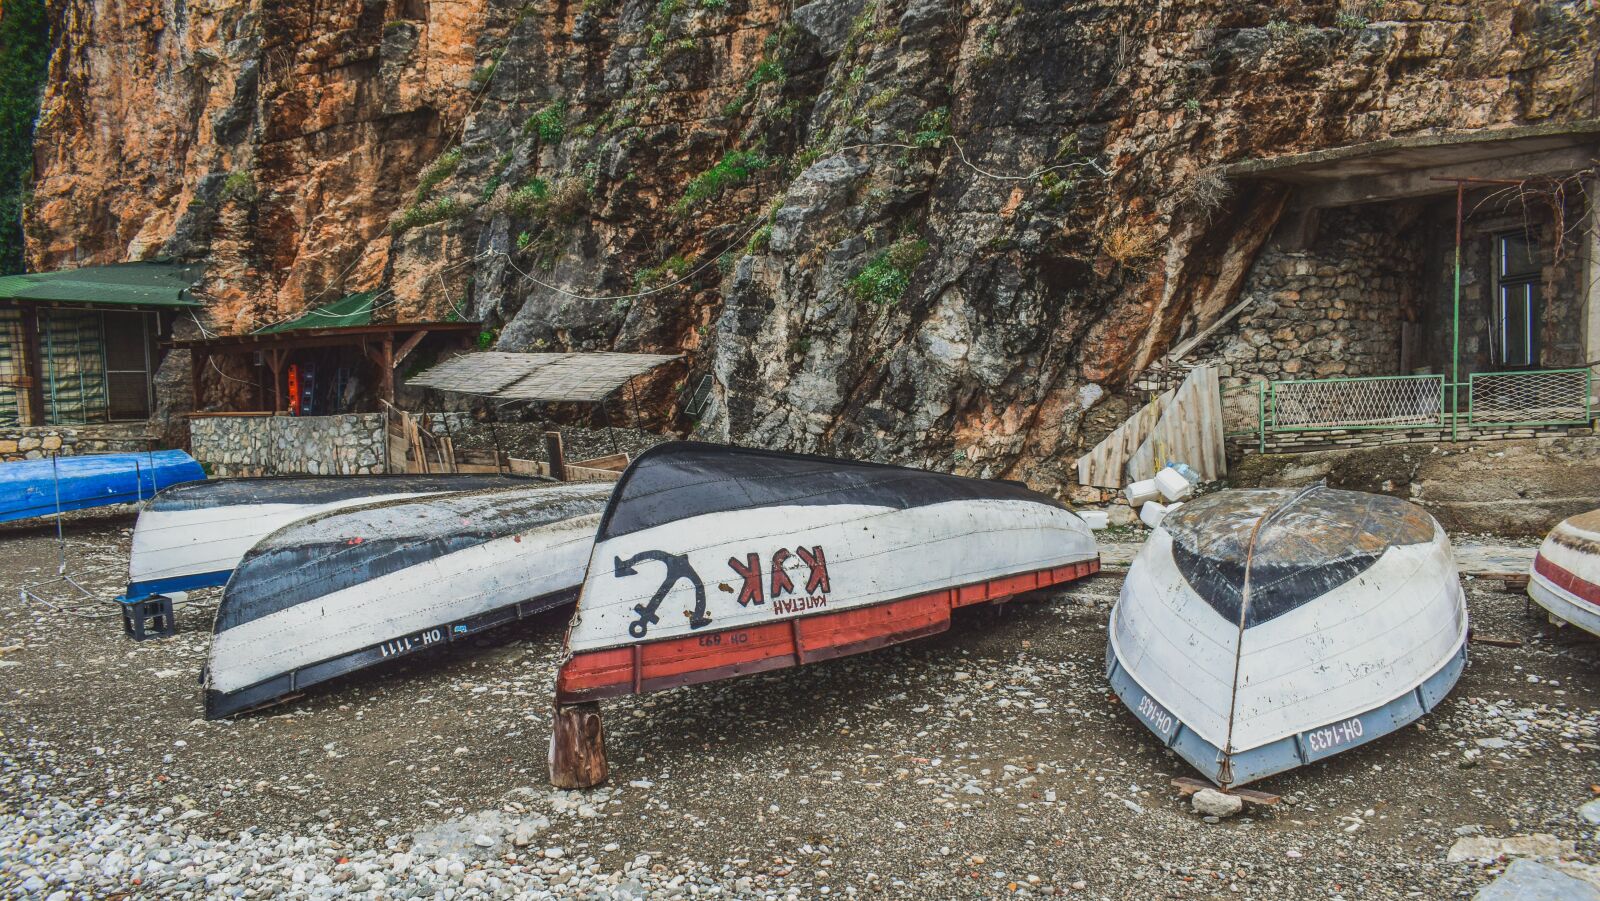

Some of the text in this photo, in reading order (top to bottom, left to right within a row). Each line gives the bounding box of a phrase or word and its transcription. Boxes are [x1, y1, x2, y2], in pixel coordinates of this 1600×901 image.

[728, 545, 831, 607] КУК
[773, 594, 827, 615] КАПЕТАН
[380, 637, 412, 657] 1111
[422, 629, 441, 645] OH
[1308, 718, 1363, 751] OH-1433
